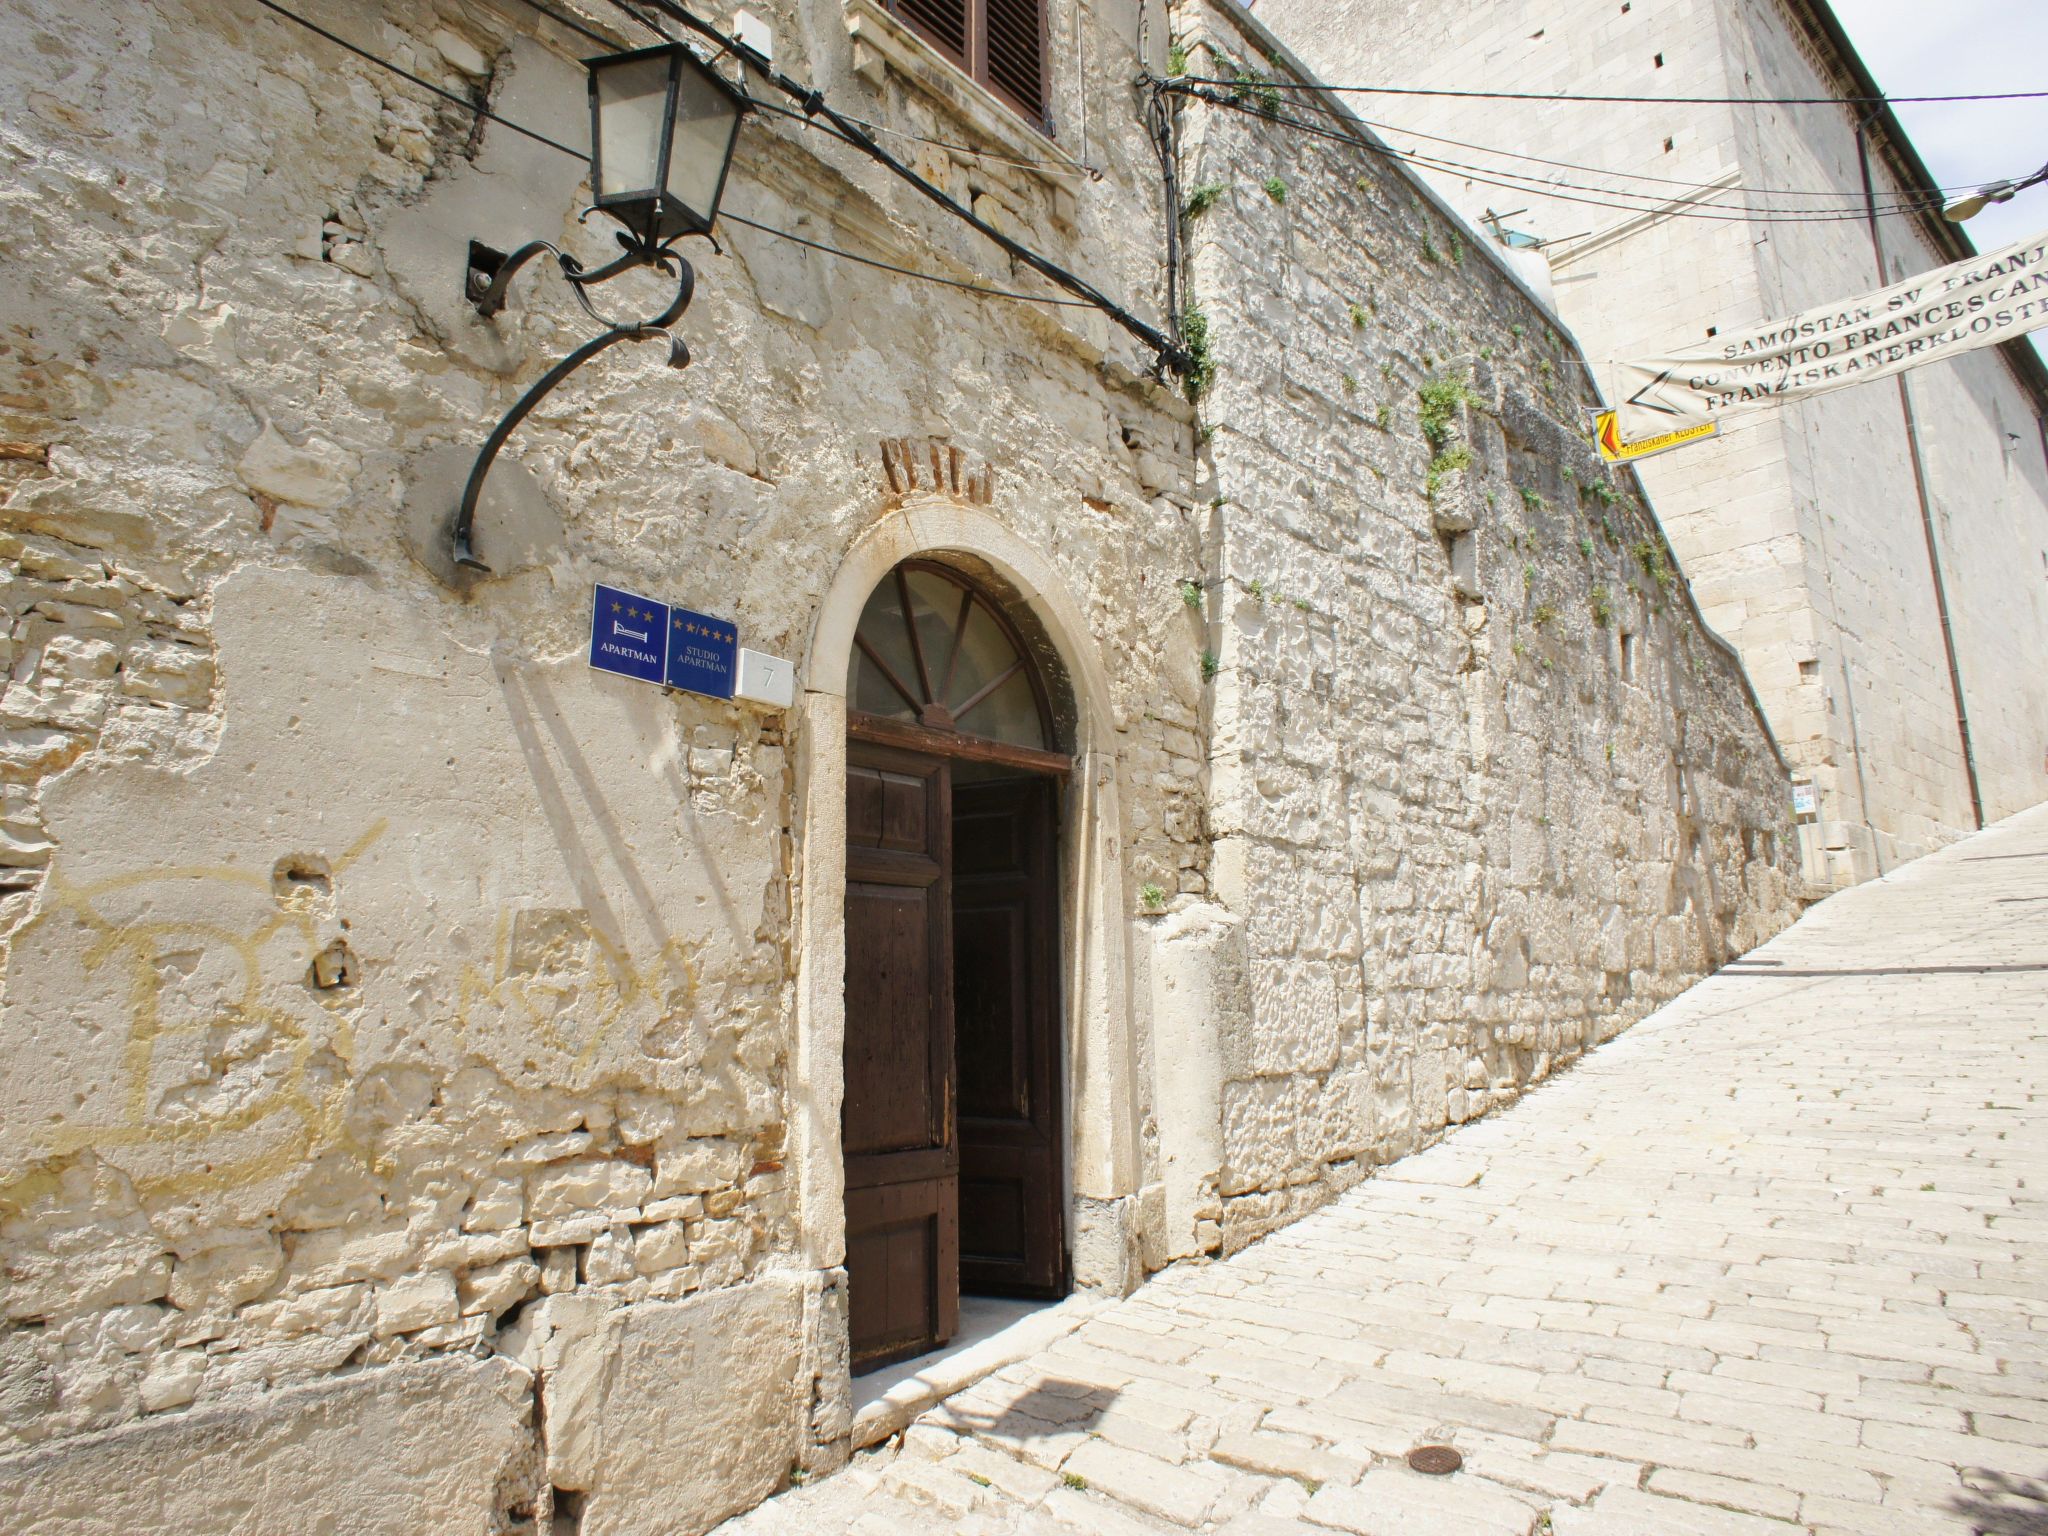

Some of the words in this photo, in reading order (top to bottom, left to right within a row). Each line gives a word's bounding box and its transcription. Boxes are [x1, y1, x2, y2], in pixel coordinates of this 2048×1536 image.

[1724, 305, 1871, 360] SAMOSTAN
[1887, 287, 1923, 312] SV
[1688, 342, 1831, 391] CONVENTO
[600, 642, 657, 664] APARTMAN
[686, 646, 720, 662] STUDIO
[677, 654, 727, 674] APARTMAN
[763, 667, 775, 687] 7
